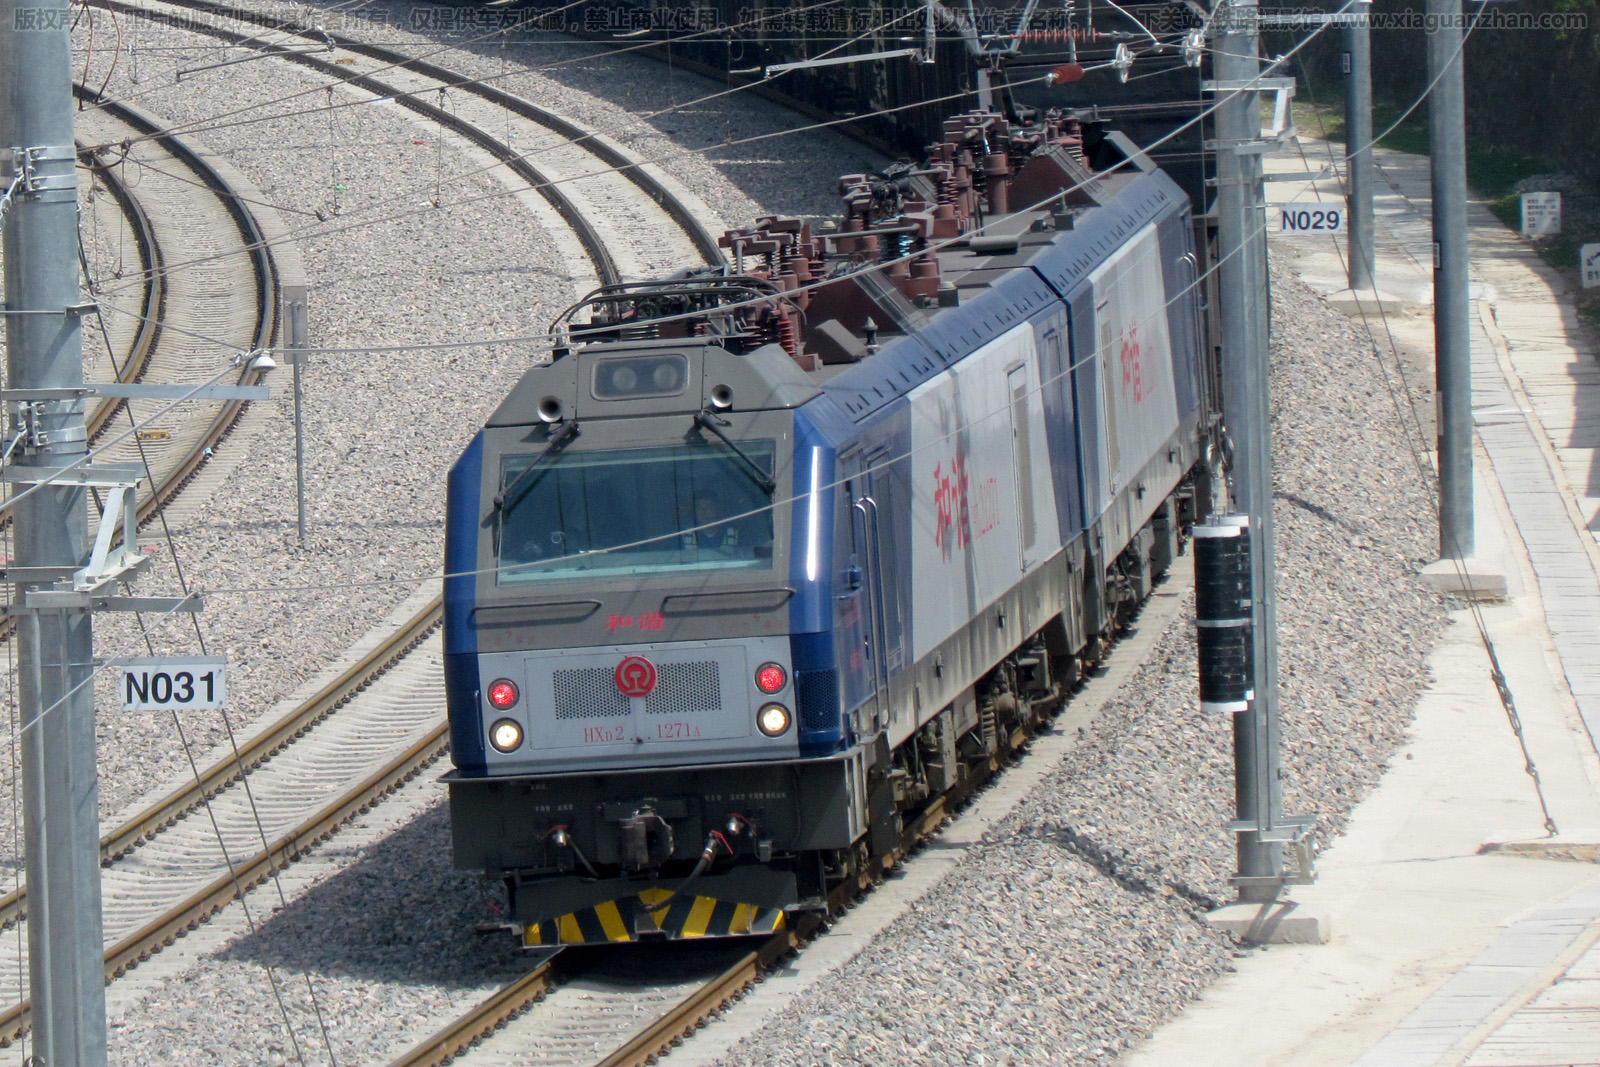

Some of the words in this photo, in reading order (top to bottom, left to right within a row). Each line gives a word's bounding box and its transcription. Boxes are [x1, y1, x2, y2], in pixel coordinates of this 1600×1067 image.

[1282, 210, 1340, 230] N029
[933, 452, 970, 564] 和谐
[604, 611, 666, 632] 和谐
[126, 671, 214, 704] N031
[657, 722, 701, 739] 1271A
